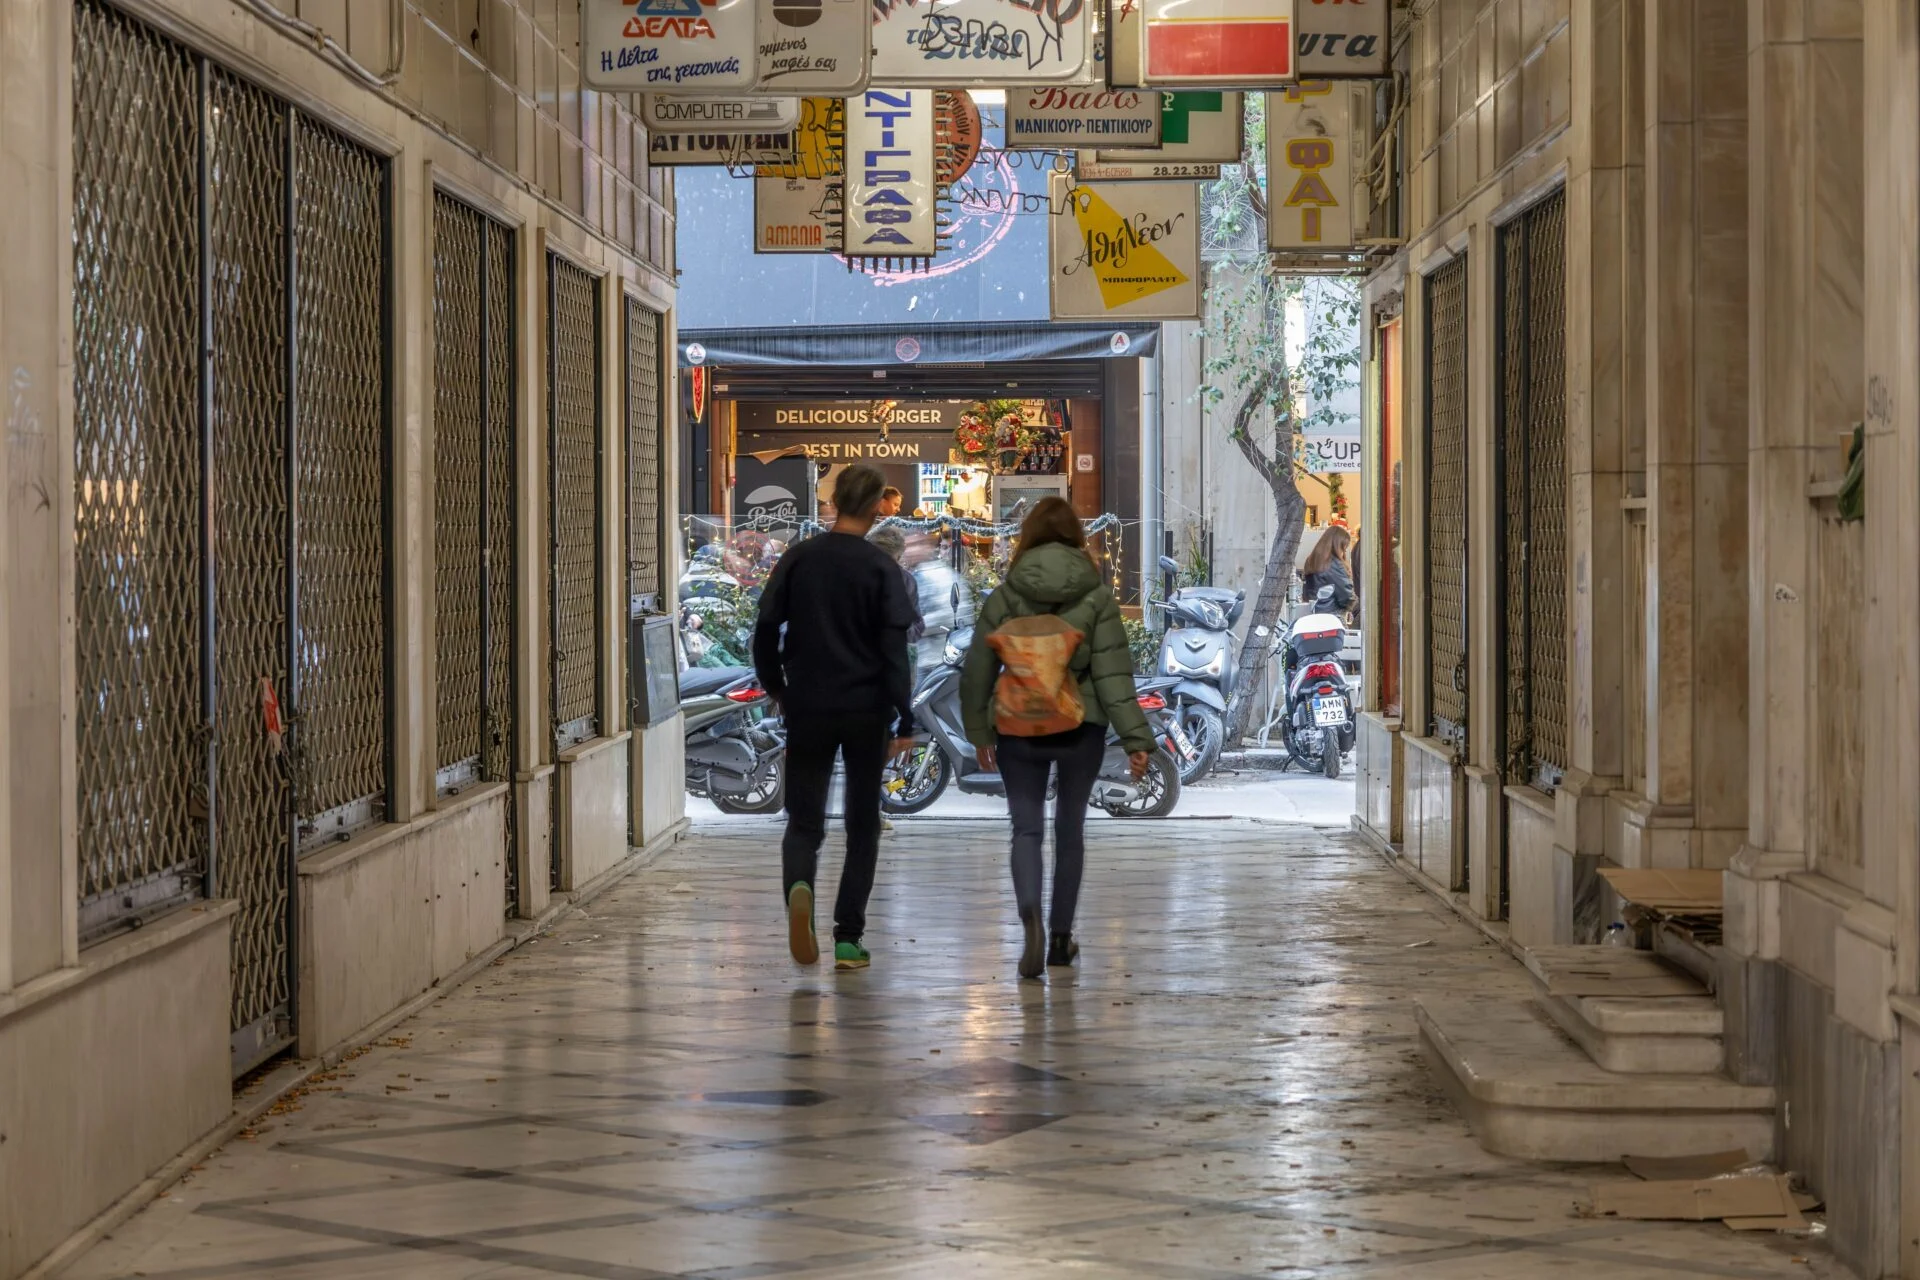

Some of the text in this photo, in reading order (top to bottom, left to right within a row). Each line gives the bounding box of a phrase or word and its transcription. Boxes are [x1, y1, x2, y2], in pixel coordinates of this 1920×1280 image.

[622, 17, 716, 39] ΔΕΛΤΑ
[601, 45, 659, 72] Η Δέλτα
[771, 55, 837, 72] καφές σας
[647, 56, 739, 83] της γειτονιάς
[655, 104, 743, 119] COMPUTER
[1153, 165, 1216, 176] 28.22.332
[776, 410, 868, 424] DELICIOUS
[844, 443, 862, 458] IN
[866, 443, 919, 458] TOWN
[1322, 711, 1344, 720] 732
